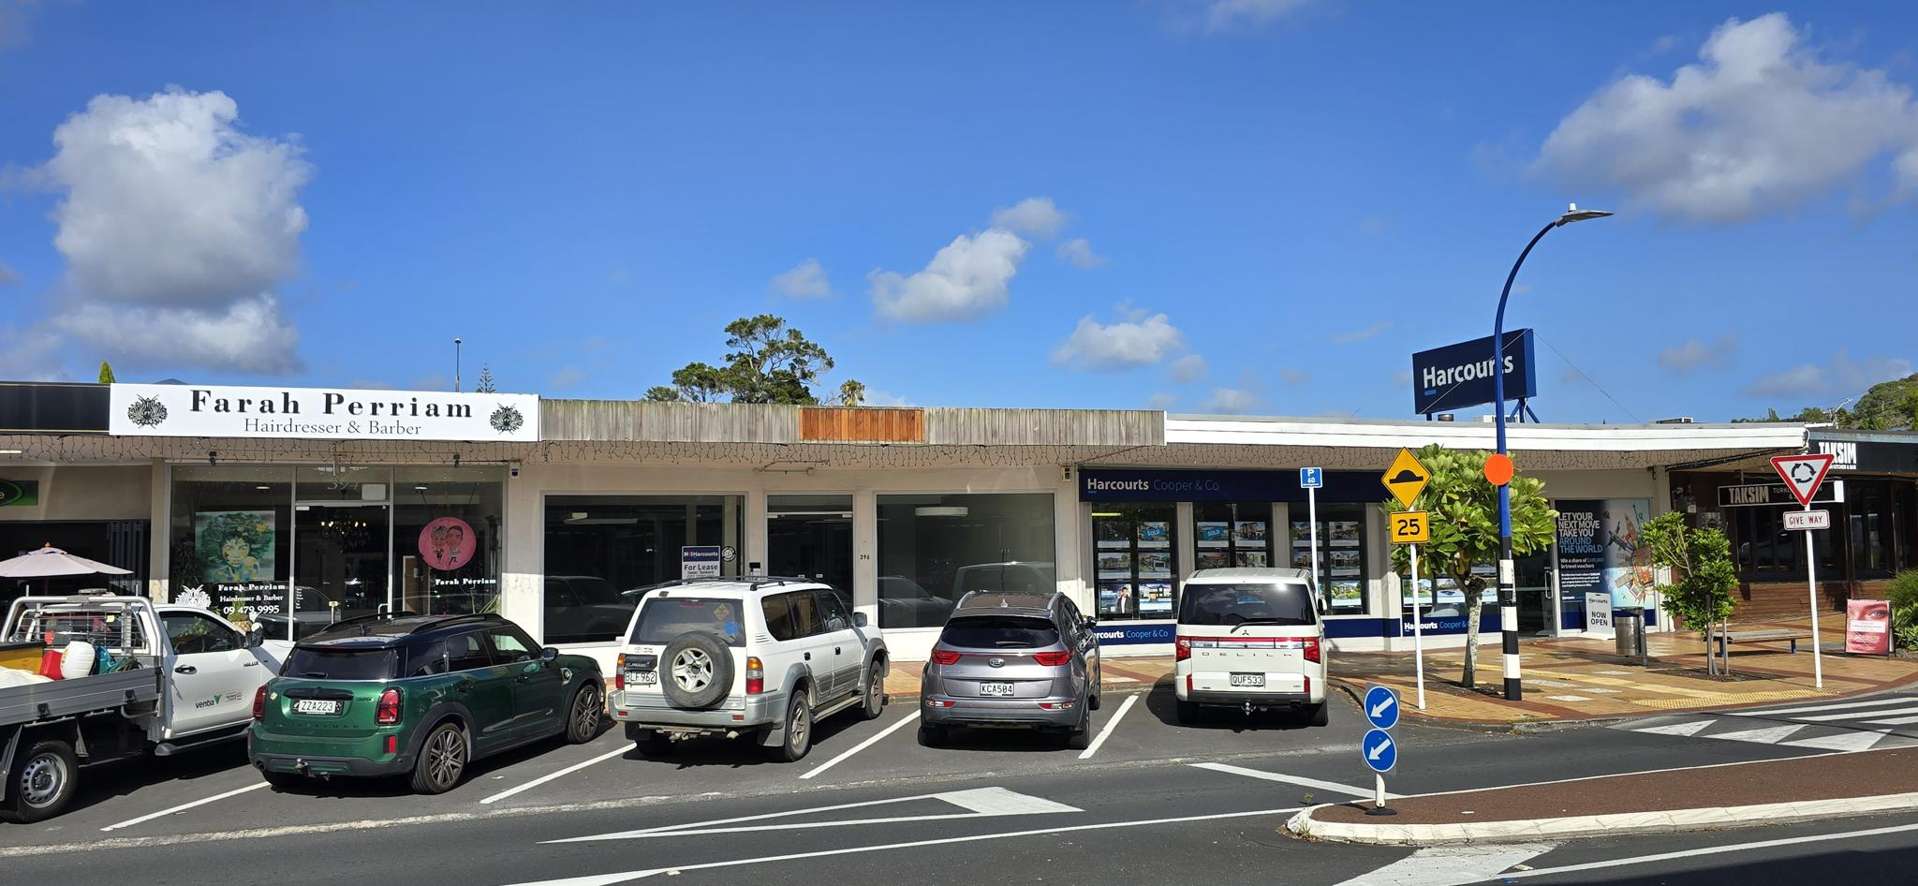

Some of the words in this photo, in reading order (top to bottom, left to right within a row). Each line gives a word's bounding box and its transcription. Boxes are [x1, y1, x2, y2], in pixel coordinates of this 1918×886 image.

[1423, 355, 1514, 389] Harcours
[190, 390, 301, 415] Farah
[322, 392, 473, 418] Perriam
[244, 418, 342, 434] Hairdresser
[347, 420, 361, 434] &
[369, 420, 422, 436] Barber
[1818, 442, 1857, 464] TAKSIM
[1307, 469, 1315, 477] P
[1087, 478, 1149, 490] Harcourts
[1153, 479, 1193, 492] Cooper
[1194, 480, 1202, 490] &
[1204, 479, 1220, 491] Co
[1729, 486, 1769, 504] TAKSIM
[1558, 512, 1570, 521] LET
[1571, 512, 1593, 521] YOUR
[1789, 516, 1804, 526] GIVE
[1808, 515, 1823, 524] WAY
[1398, 518, 1420, 535] 25
[1558, 521, 1578, 529] NEXT
[1579, 520, 1601, 528] MOVE
[1558, 529, 1578, 537] TAKE
[1578, 529, 1594, 537] YOU
[1559, 537, 1592, 545] AROUND
[1560, 545, 1575, 553] THE
[1575, 544, 1604, 553] WORLD
[462, 577, 497, 585] Perriam
[248, 583, 285, 591] Perriam
[223, 606, 235, 614] 09
[237, 605, 255, 614] 479
[257, 605, 280, 614] 9995
[1591, 611, 1607, 619] NOW
[1404, 621, 1438, 629] Haourts
[1439, 621, 1461, 630] Cooper
[1590, 618, 1608, 626] OPEN
[1126, 630, 1151, 639] Cooper
[1152, 630, 1158, 638] &
[1159, 629, 1168, 637] Co
[1232, 676, 1263, 685] QUF533
[301, 701, 333, 711] ZZA223
